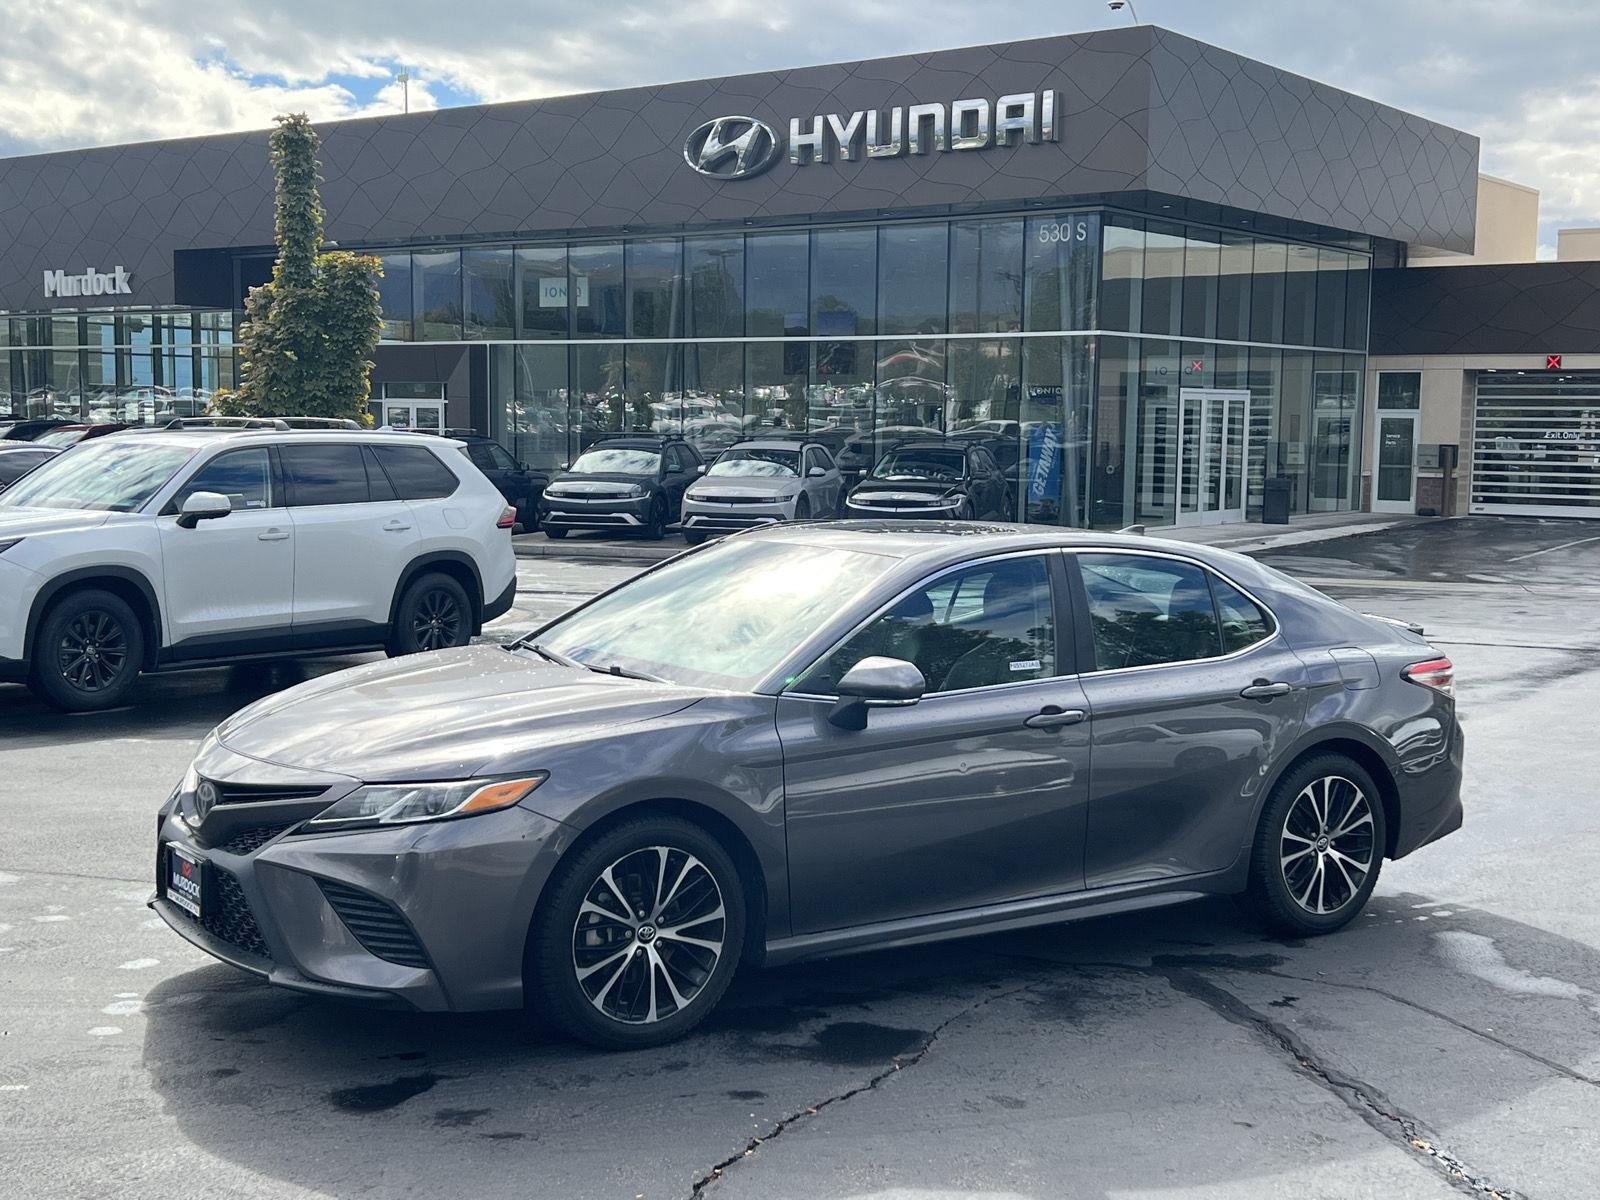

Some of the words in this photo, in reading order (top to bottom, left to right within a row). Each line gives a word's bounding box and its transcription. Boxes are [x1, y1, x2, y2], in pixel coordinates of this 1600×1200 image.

[789, 89, 1060, 165] HYUNDAI
[1039, 223, 1071, 243] 530
[1076, 222, 1087, 241] S
[43, 265, 133, 298] Murdock
[1154, 366, 1193, 376] IOQ
[1544, 431, 1561, 439] Exit
[1562, 431, 1580, 441] Only
[172, 871, 201, 898] MURDOCK
